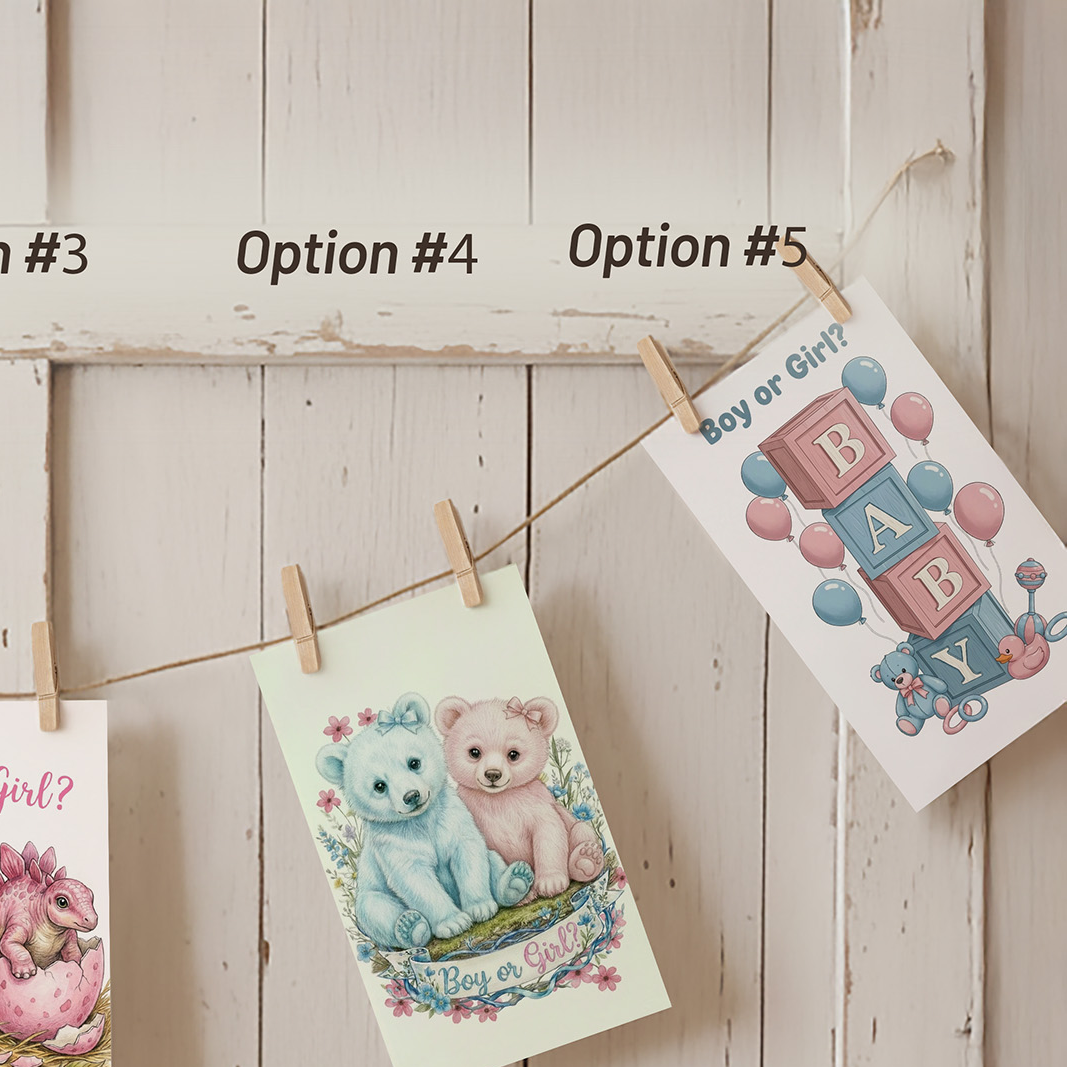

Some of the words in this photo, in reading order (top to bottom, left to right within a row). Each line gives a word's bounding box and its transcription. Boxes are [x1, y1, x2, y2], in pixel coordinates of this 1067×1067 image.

[699, 399, 752, 445] Boy
[753, 374, 782, 406] or
[785, 323, 848, 380] Girl?
[437, 965, 492, 997] Boy
[496, 961, 523, 982] or
[523, 921, 581, 975] Girl?
